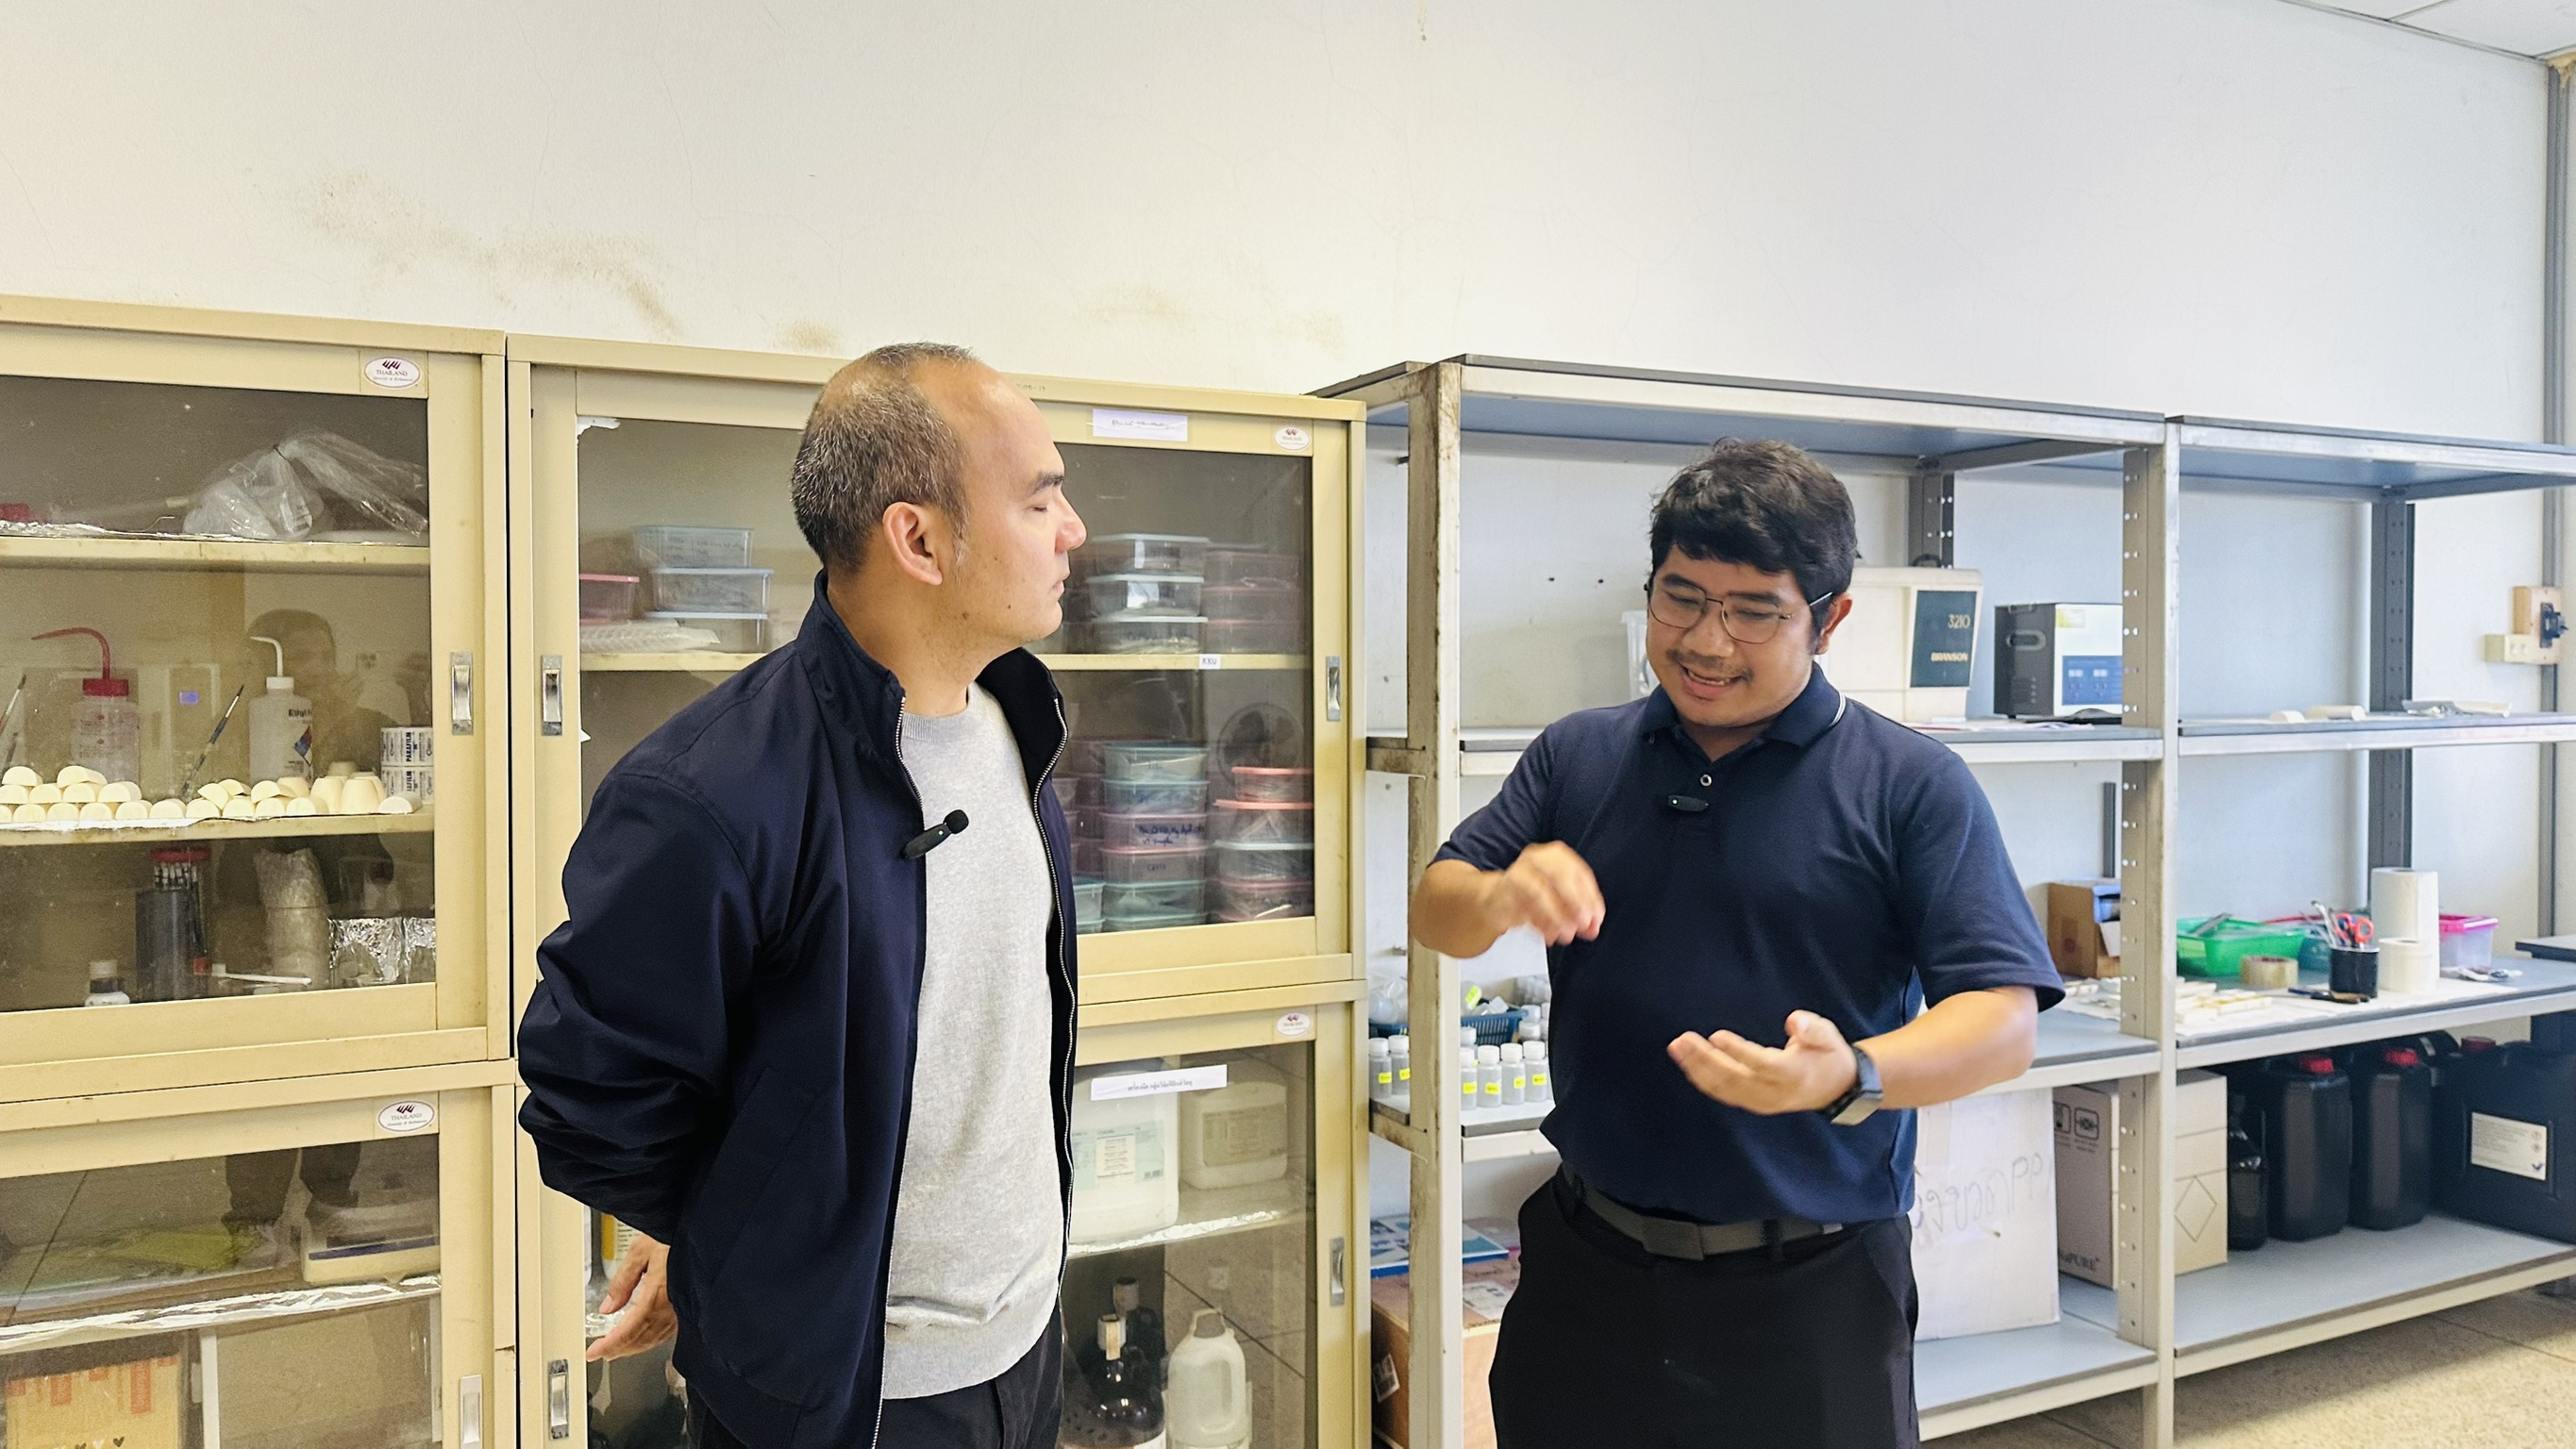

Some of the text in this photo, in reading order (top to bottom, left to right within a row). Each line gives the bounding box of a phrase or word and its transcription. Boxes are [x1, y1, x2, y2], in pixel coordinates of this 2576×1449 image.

[1948, 613, 1971, 629] 3210
[1931, 652, 1968, 662] BRANSON
[391, 1112, 423, 1121] THAILAND
